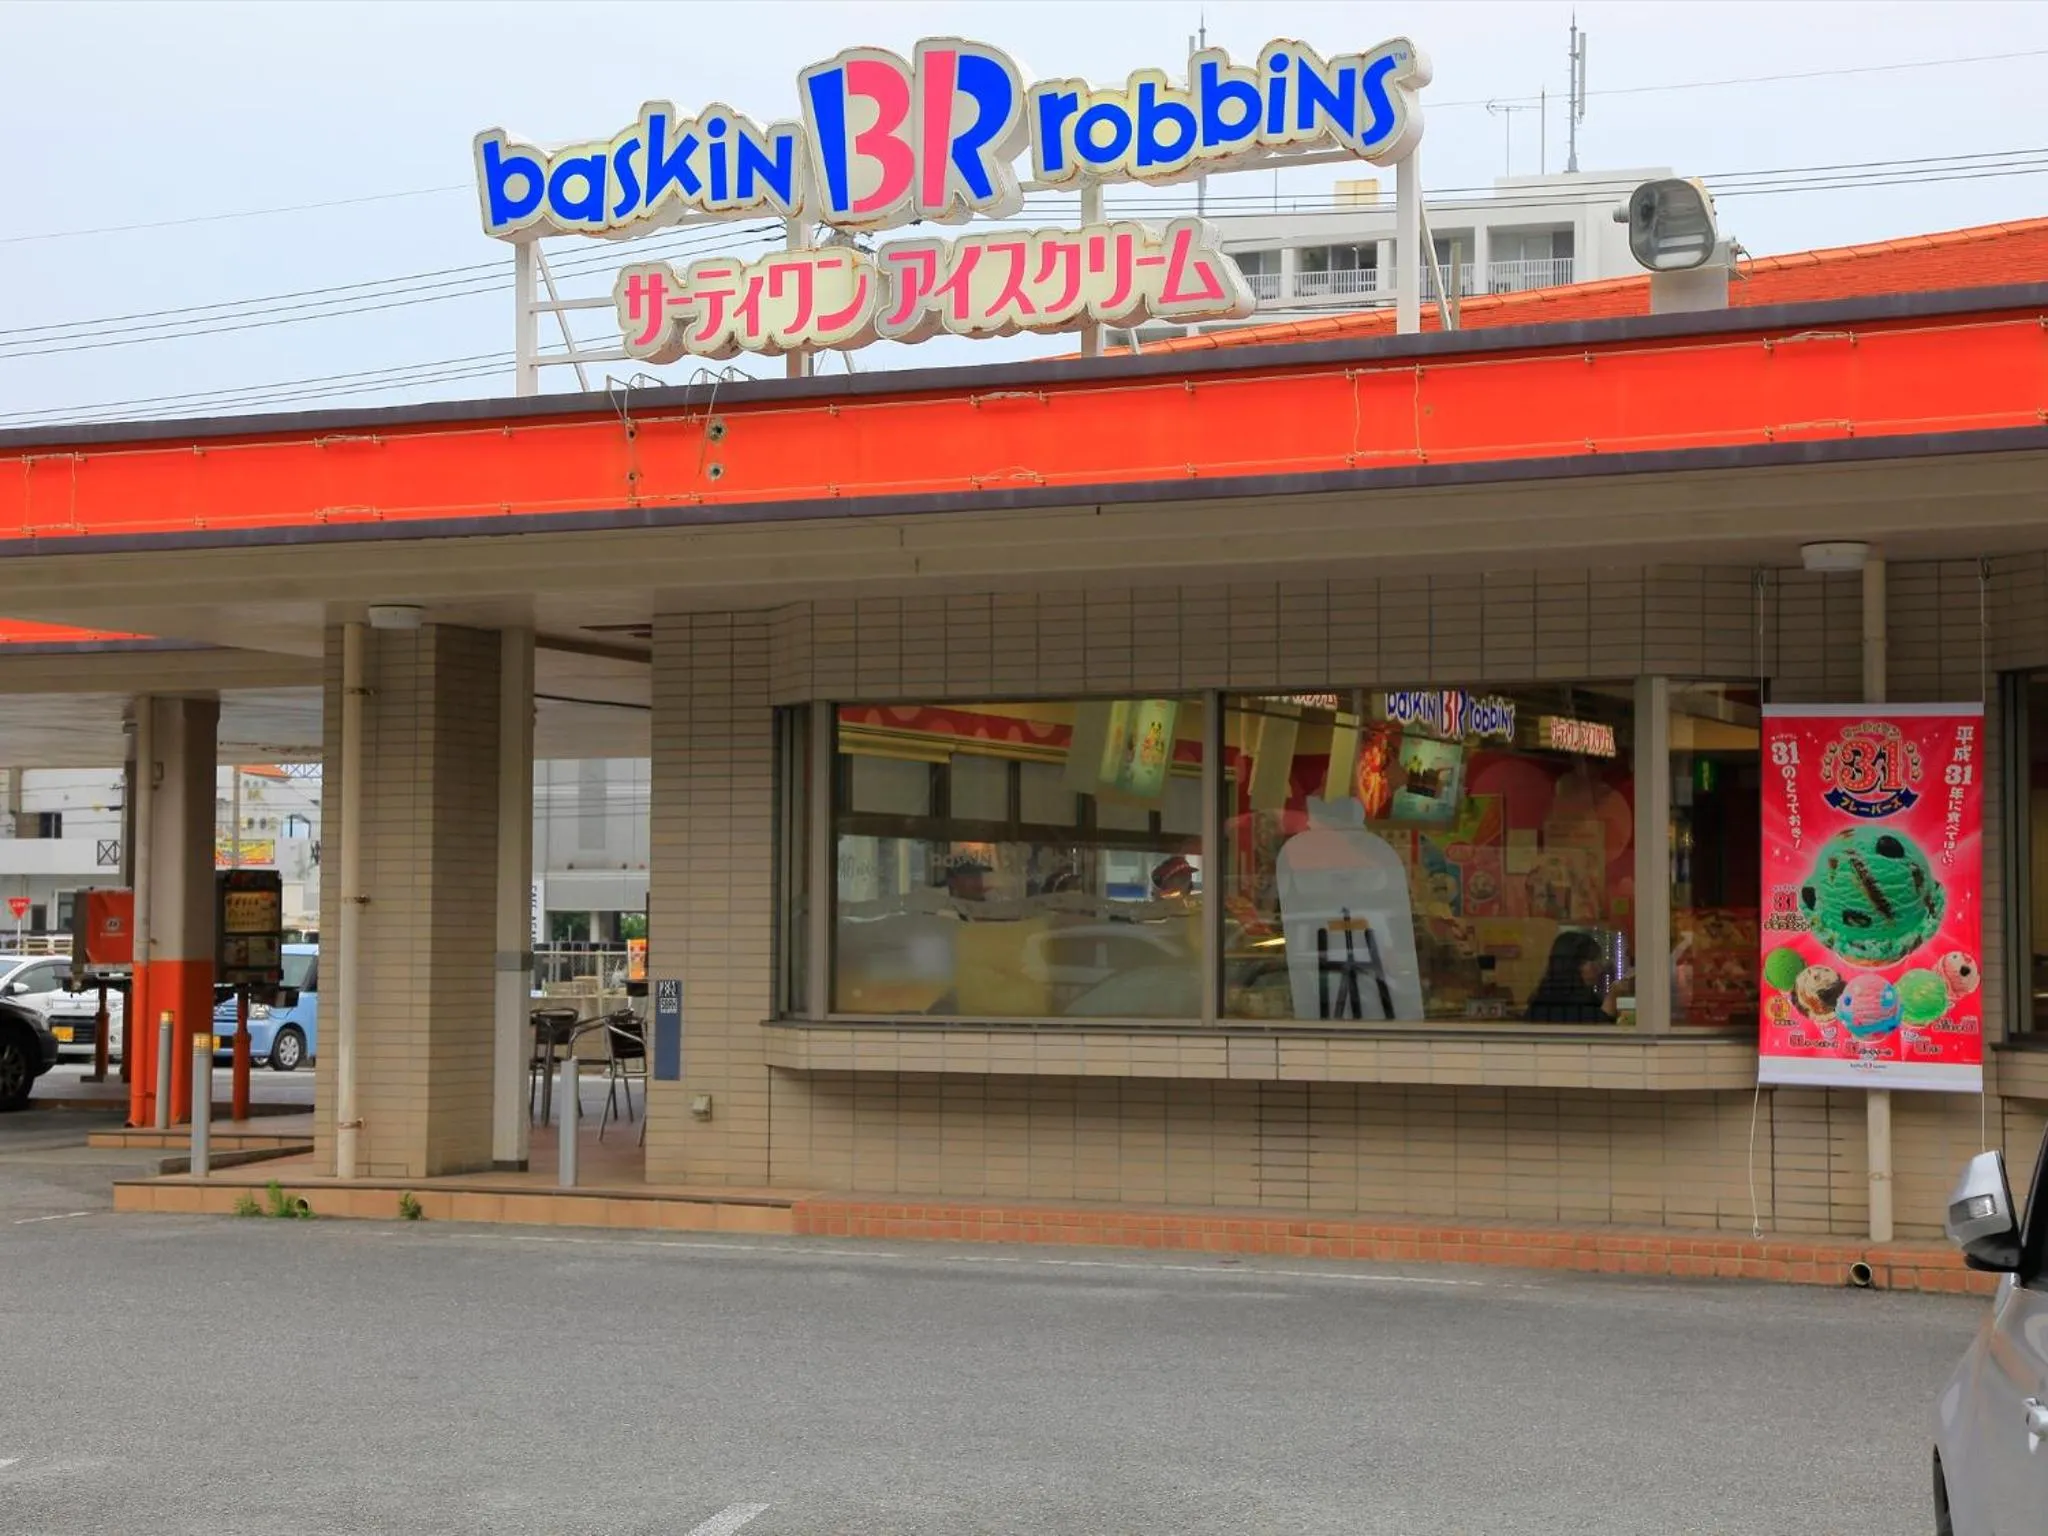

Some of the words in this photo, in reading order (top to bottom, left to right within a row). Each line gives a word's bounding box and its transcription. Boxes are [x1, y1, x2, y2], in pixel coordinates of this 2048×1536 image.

[483, 114, 796, 225] baskin
[1037, 52, 1397, 172] robbins
[625, 259, 867, 346] サーティワン
[886, 228, 1226, 327] アイスクリーム
[1840, 740, 1904, 791] 31
